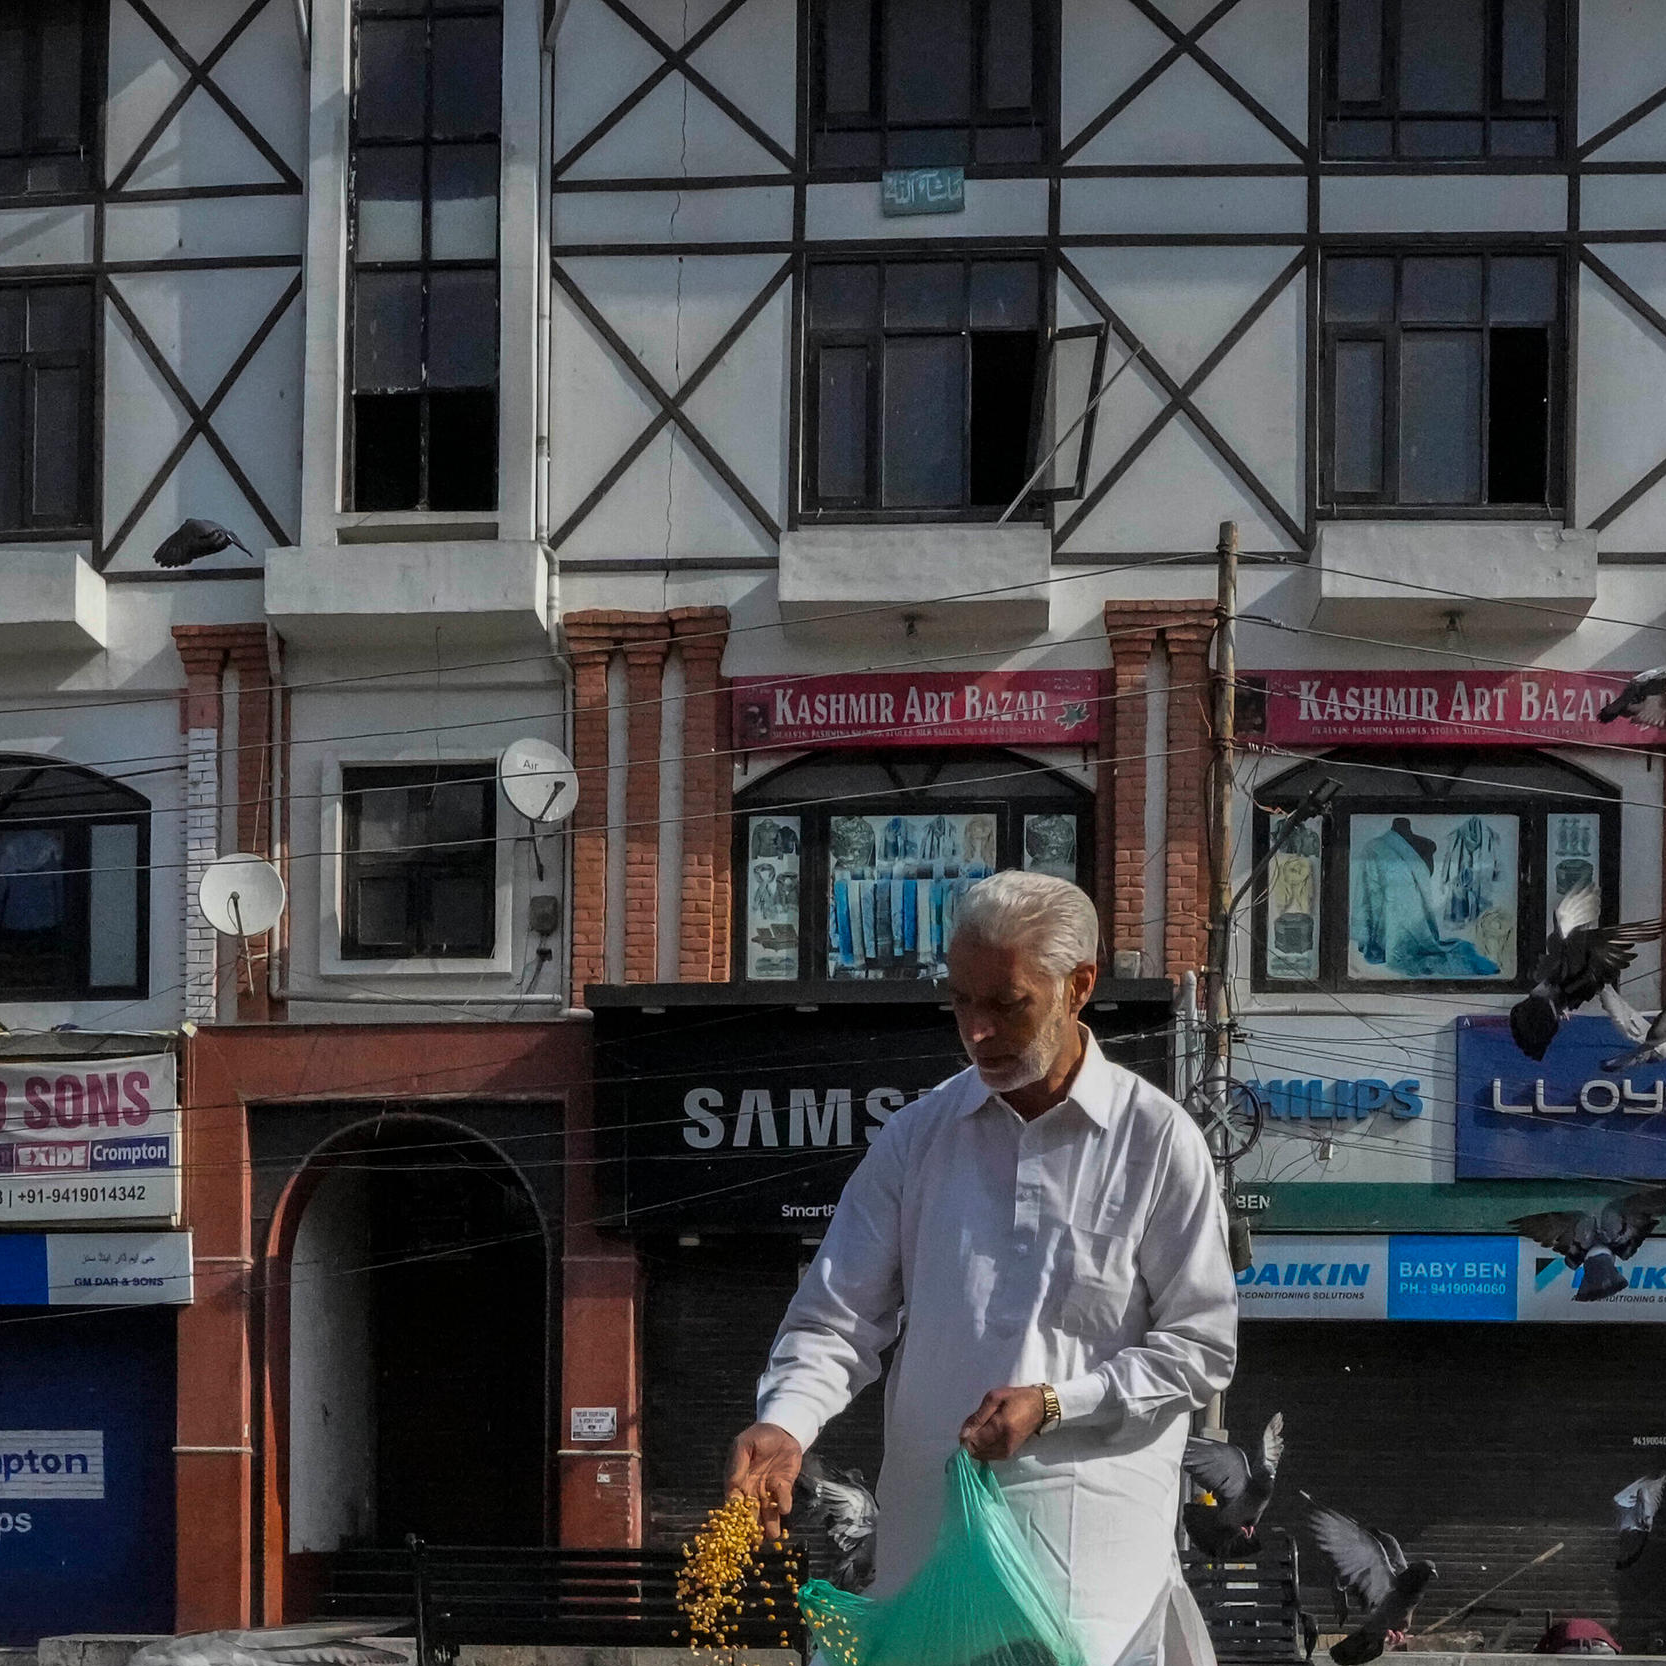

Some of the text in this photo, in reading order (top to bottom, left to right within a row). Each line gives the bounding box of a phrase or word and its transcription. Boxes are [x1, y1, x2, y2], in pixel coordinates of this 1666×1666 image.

[773, 684, 1047, 725] KASHMIR ART BAZAR
[1298, 680, 1440, 721] KASHMIR
[1448, 680, 1509, 721] ART
[23, 1070, 150, 1129] SONS
[1239, 1079, 1424, 1121] HILIPS
[683, 1087, 929, 1149] SAMS
[18, 1146, 85, 1167] EXIDE
[92, 1141, 166, 1164] Crompton
[17, 1185, 145, 1204] +91-9419014342
[1236, 1196, 1270, 1210] BEN
[781, 1203, 837, 1218] SmartP
[74, 1277, 92, 1287] GM
[93, 1277, 119, 1287] DAR
[132, 1277, 164, 1287] SONS
[1399, 1262, 1507, 1285] BABY BEN
[1237, 1291, 1366, 1301] R-CONDITIONING SOLUTIONS
[1430, 1283, 1507, 1299] 9419004060
